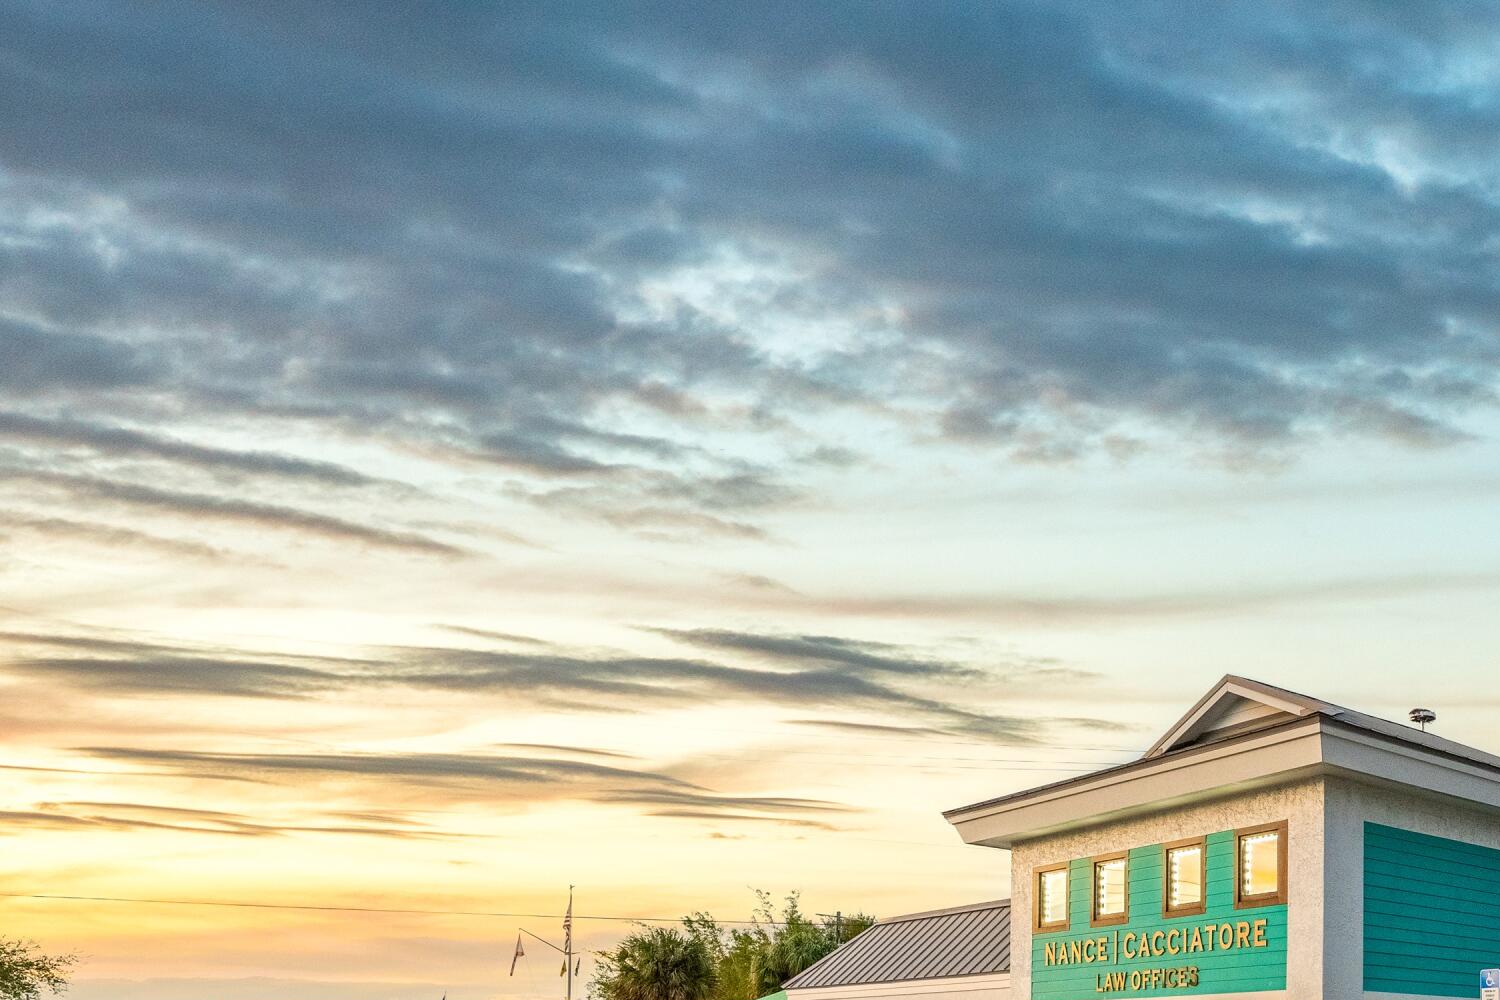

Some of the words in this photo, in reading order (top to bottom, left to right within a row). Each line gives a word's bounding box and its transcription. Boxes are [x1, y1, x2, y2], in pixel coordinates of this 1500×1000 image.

[1045, 936, 1108, 965] NANCE
[1123, 918, 1268, 959] CACCIATORE
[1096, 972, 1127, 993] LAW
[1131, 966, 1199, 991] OFFICES
